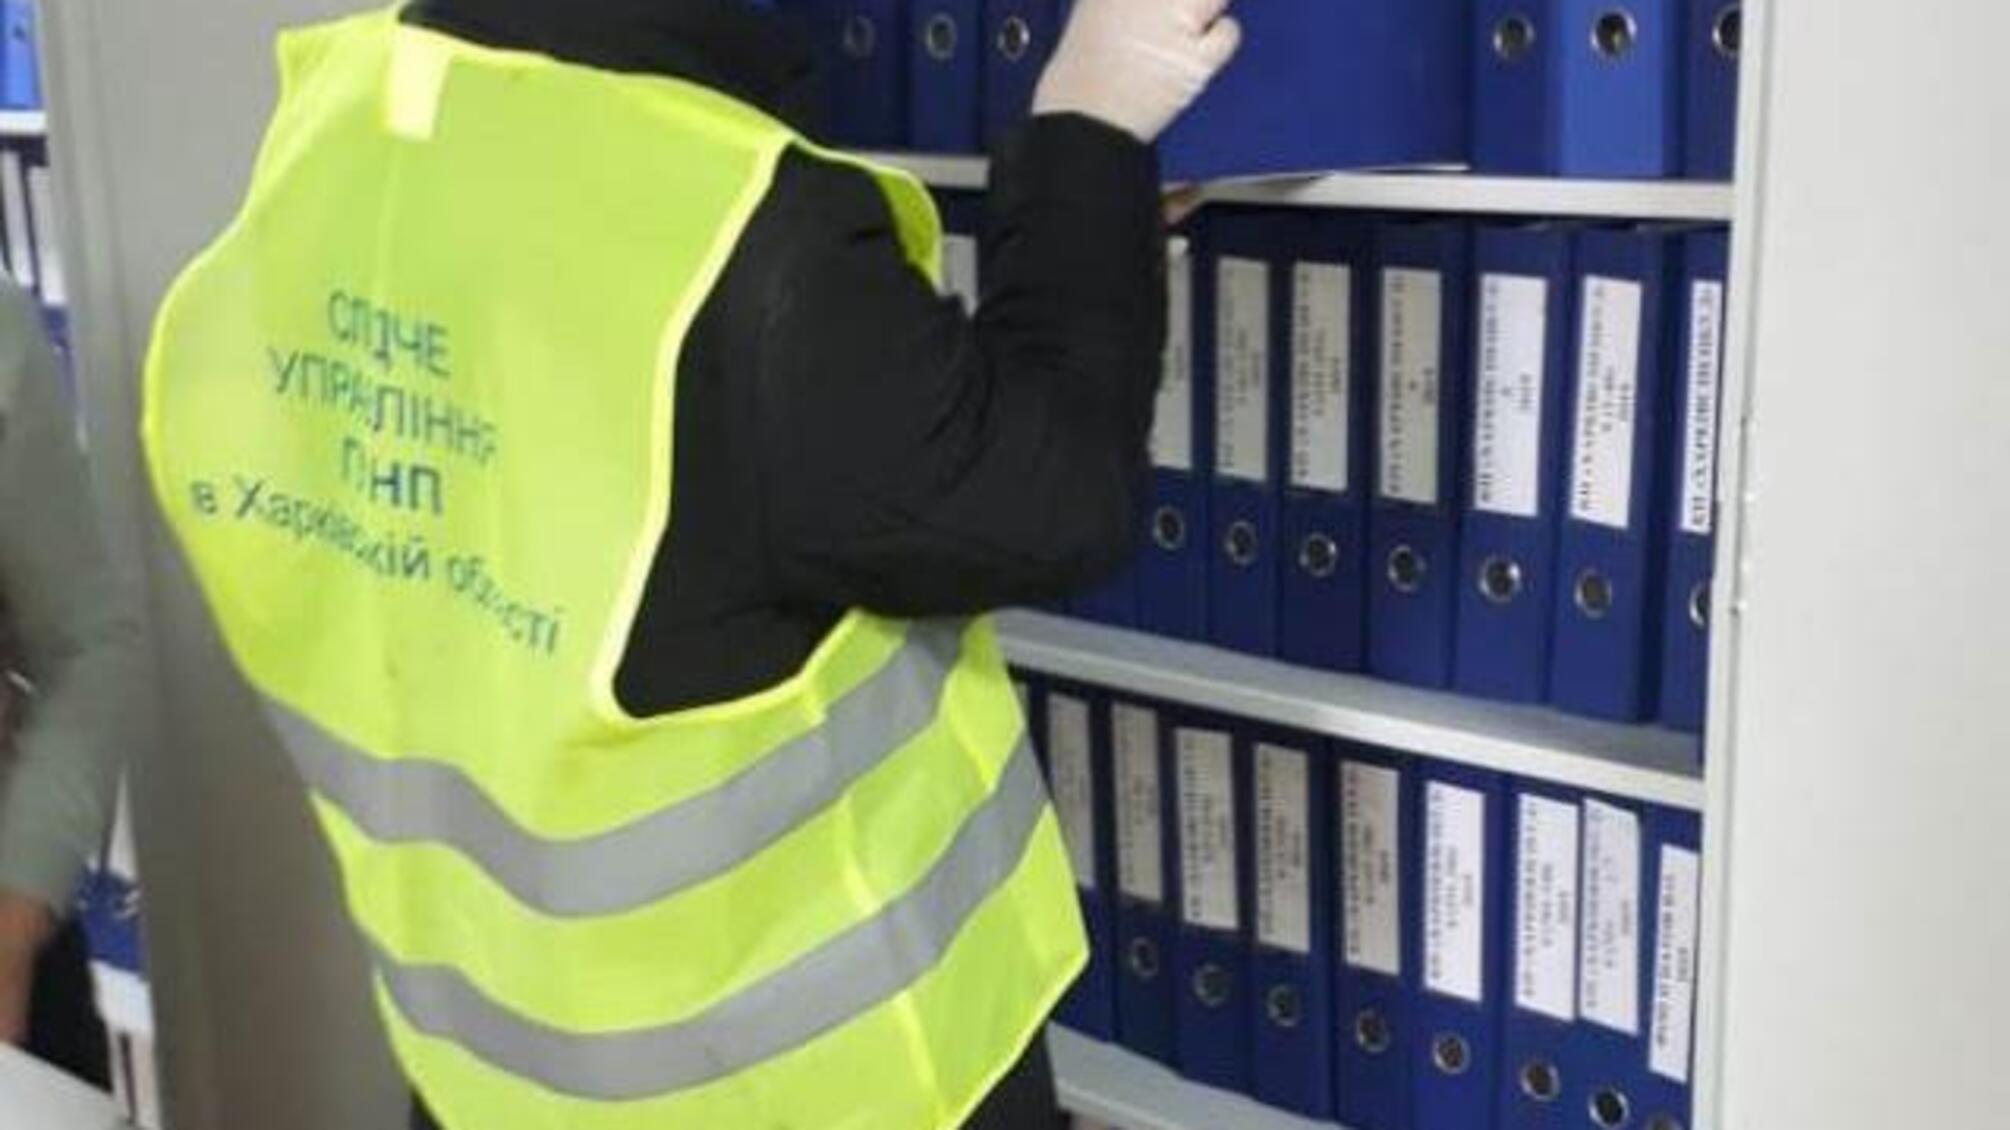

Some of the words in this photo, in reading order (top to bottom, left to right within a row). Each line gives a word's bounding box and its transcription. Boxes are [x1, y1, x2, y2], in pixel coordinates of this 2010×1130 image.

[327, 289, 452, 380] СЛДЧЕ
[268, 345, 497, 466] УПРАЛІНН
[342, 437, 444, 518] ГНП
[190, 480, 218, 516] в
[446, 555, 567, 658] облсті
